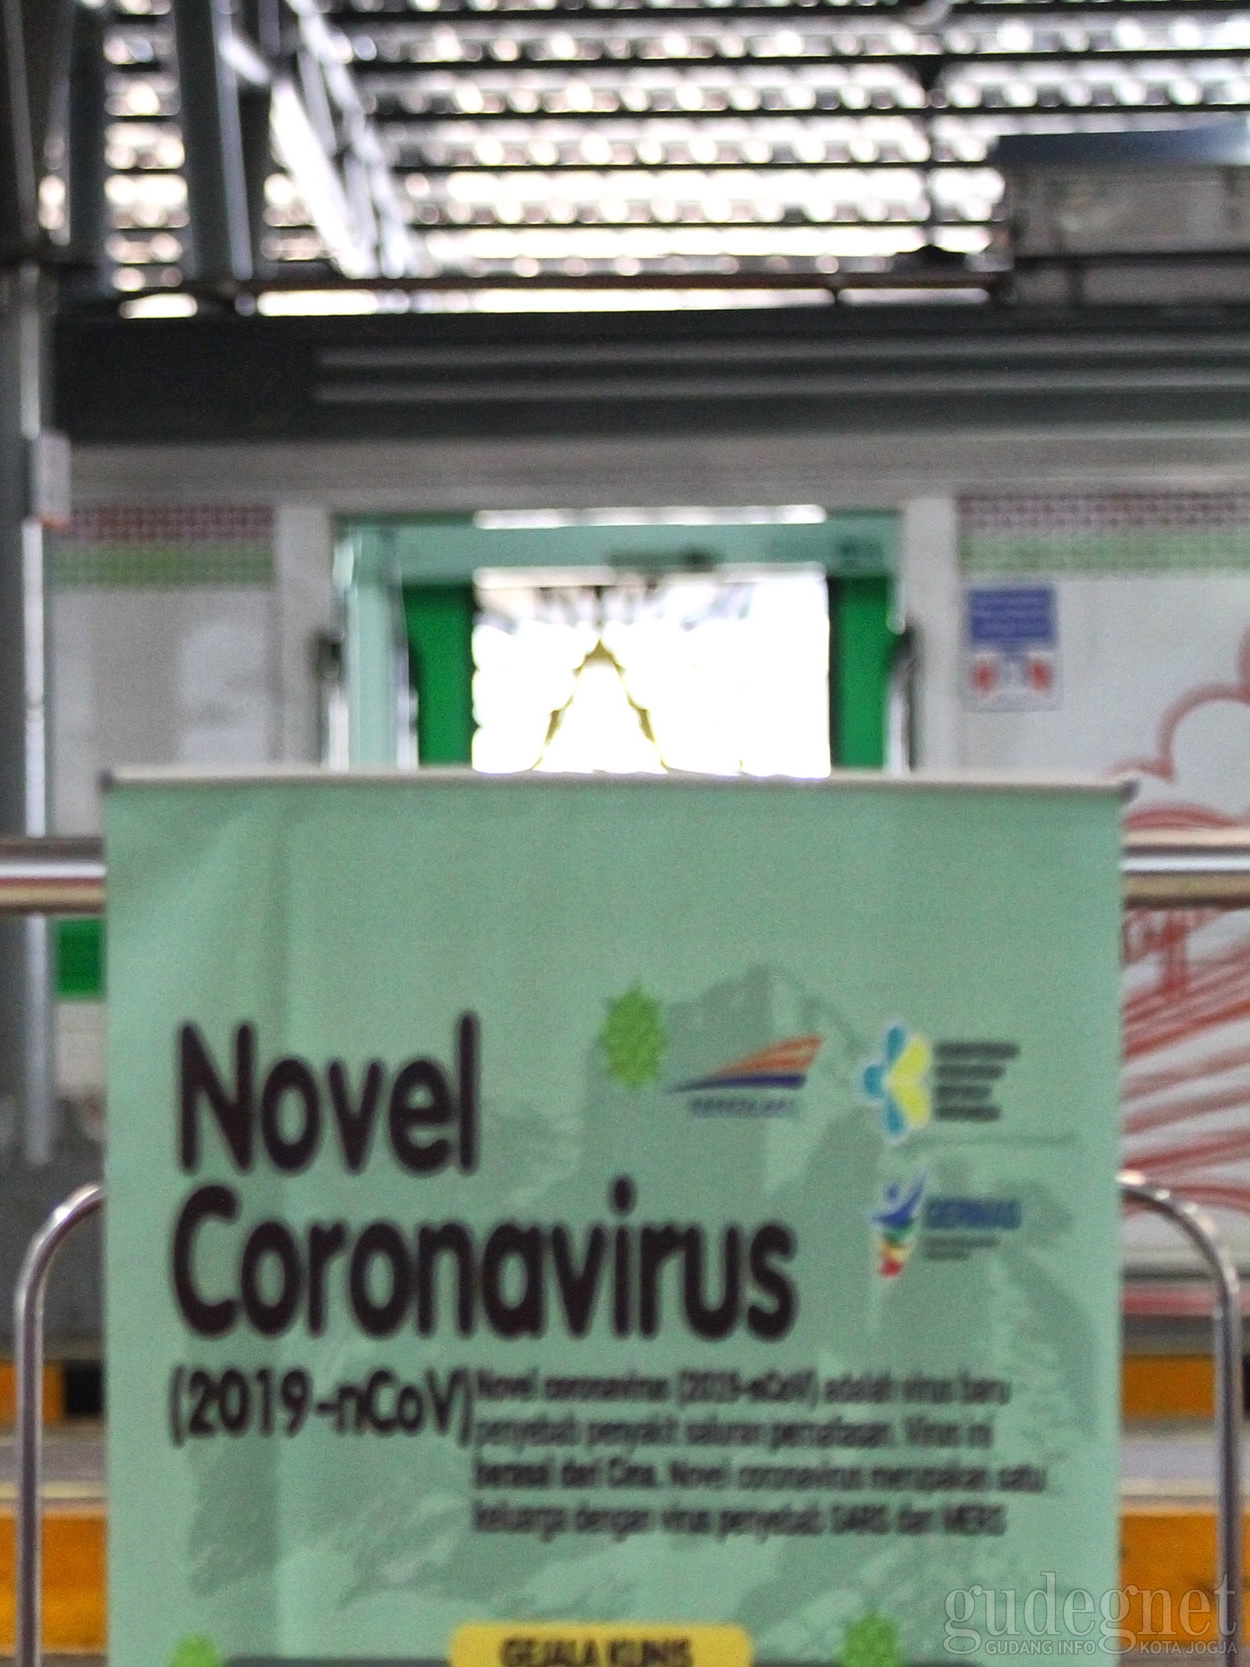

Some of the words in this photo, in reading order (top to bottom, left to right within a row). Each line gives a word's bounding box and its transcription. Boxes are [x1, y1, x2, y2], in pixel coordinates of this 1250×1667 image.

[177, 1011, 480, 1176] Novel
[172, 1174, 800, 1340] Coronavirus
[171, 1365, 472, 1446] (2019-nCoV)
